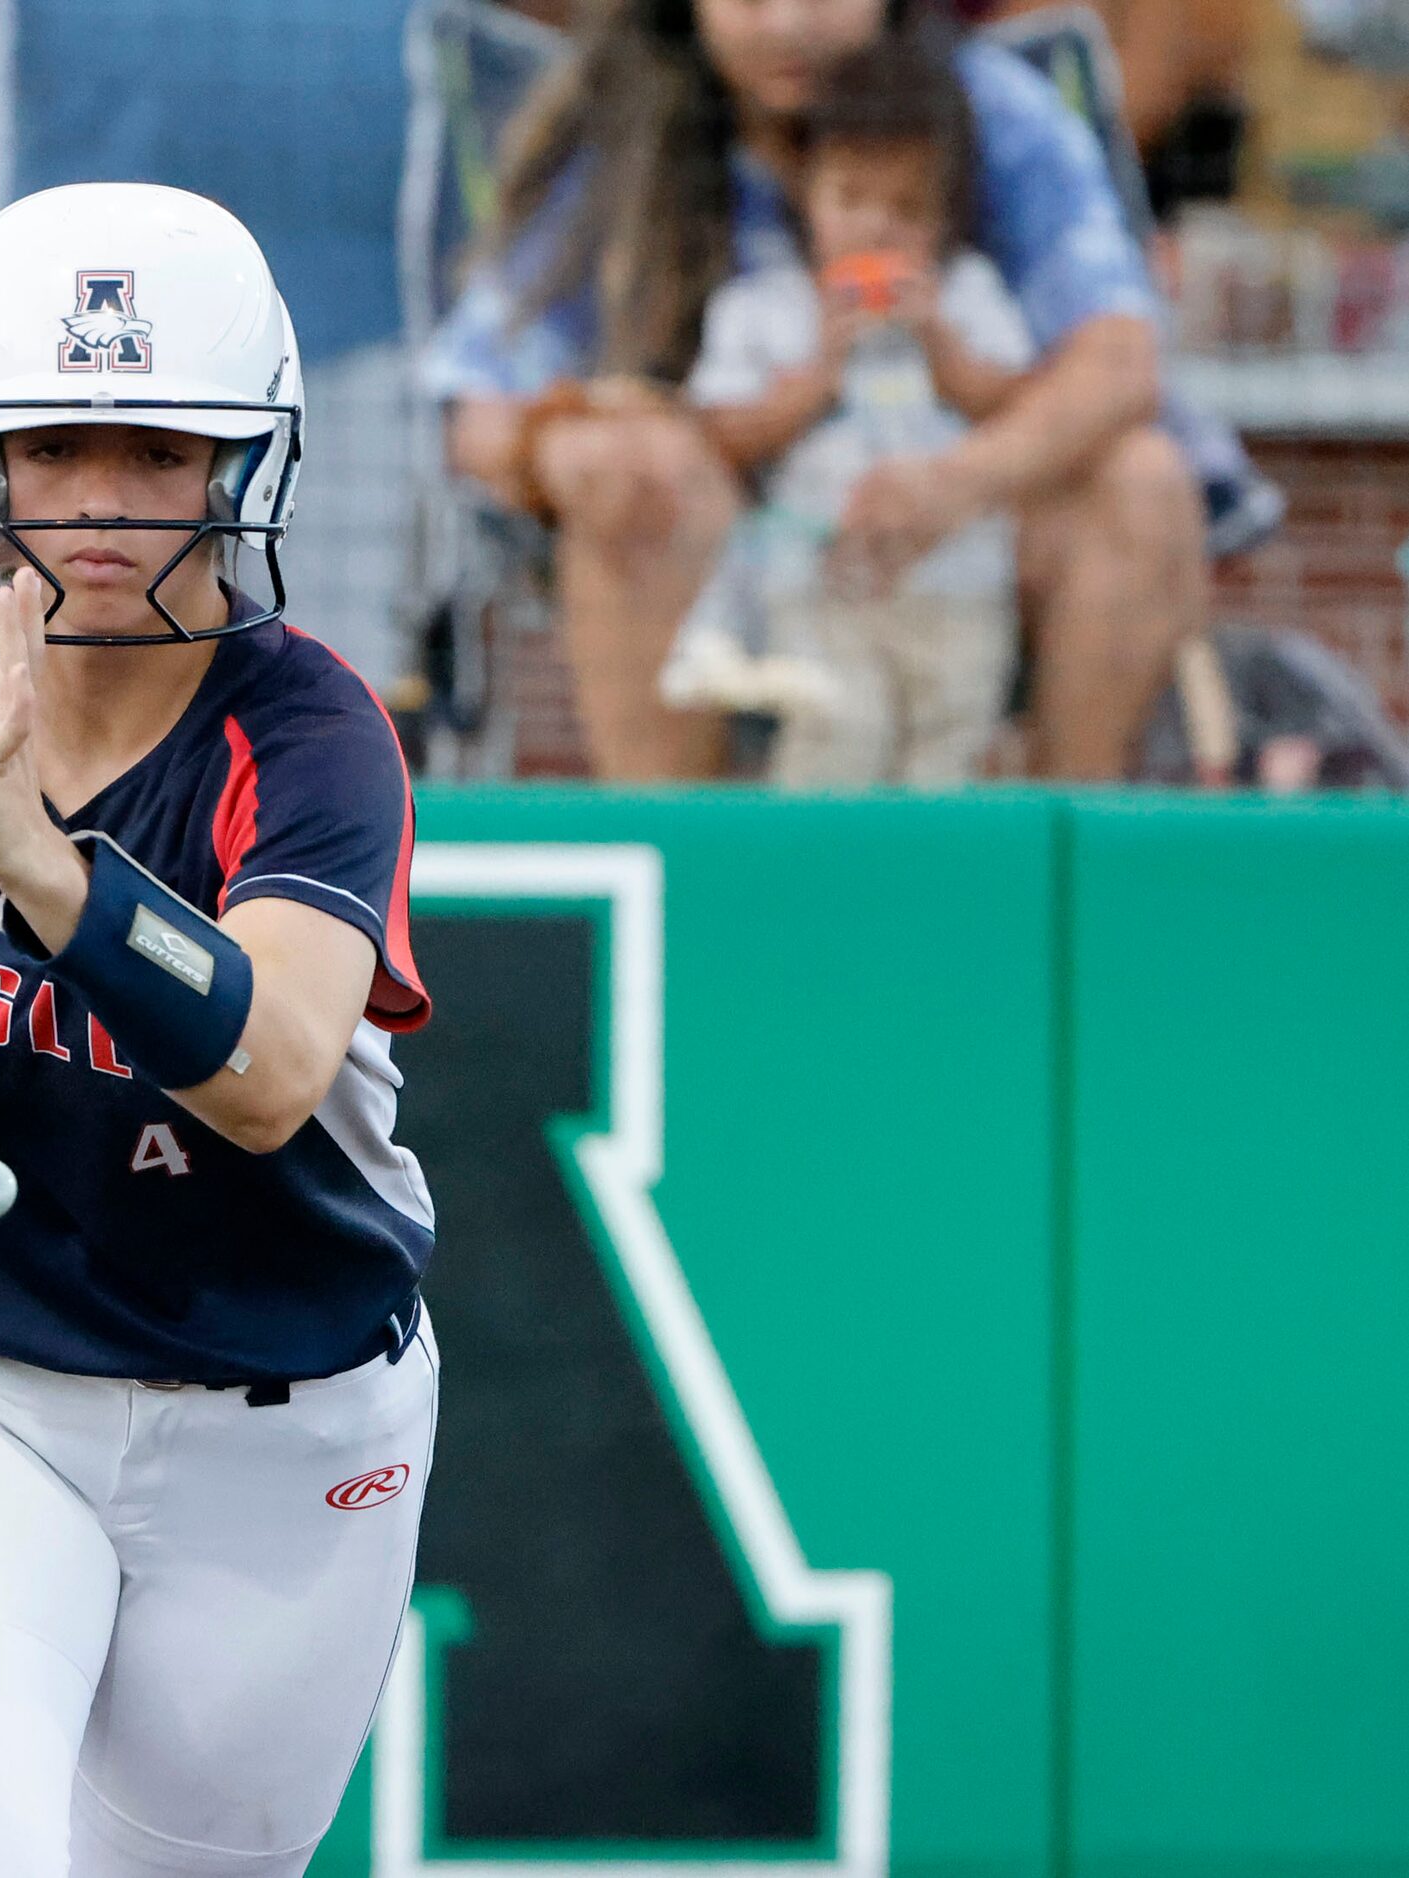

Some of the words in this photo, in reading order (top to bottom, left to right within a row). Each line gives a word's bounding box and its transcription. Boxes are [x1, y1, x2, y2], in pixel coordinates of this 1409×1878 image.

[58, 269, 152, 374] A
[134, 933, 208, 984] CUTTERS
[130, 1121, 192, 1177] 4
